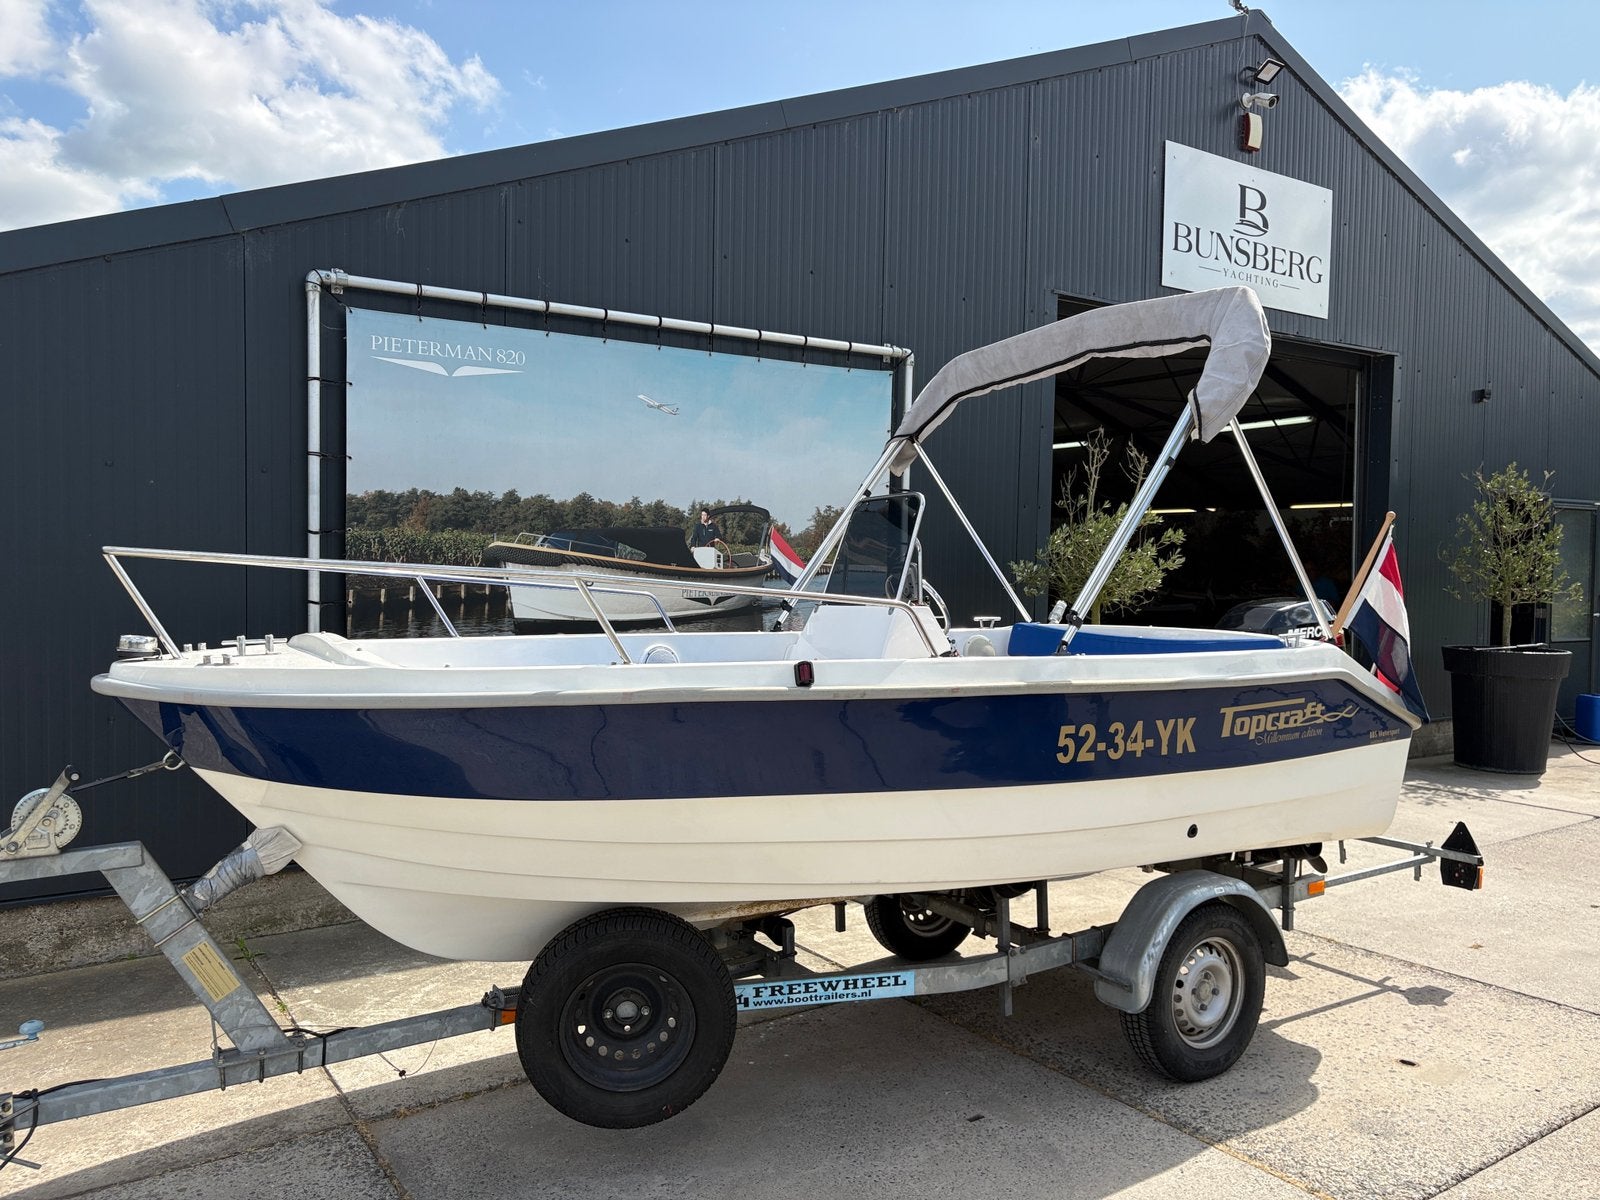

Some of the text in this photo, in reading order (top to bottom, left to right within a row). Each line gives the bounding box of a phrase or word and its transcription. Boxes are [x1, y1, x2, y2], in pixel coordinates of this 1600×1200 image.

[1236, 184, 1269, 234] B
[1173, 222, 1323, 284] BUNSBERG
[1223, 267, 1279, 288] YACHTING
[371, 335, 526, 365] PIETERMAN 820
[1220, 698, 1326, 740] Topcraft
[1056, 717, 1197, 764] 52-34-YK
[752, 975, 907, 998] FREEWHEEL
[752, 989, 872, 1008] www.boottrailers.nl
